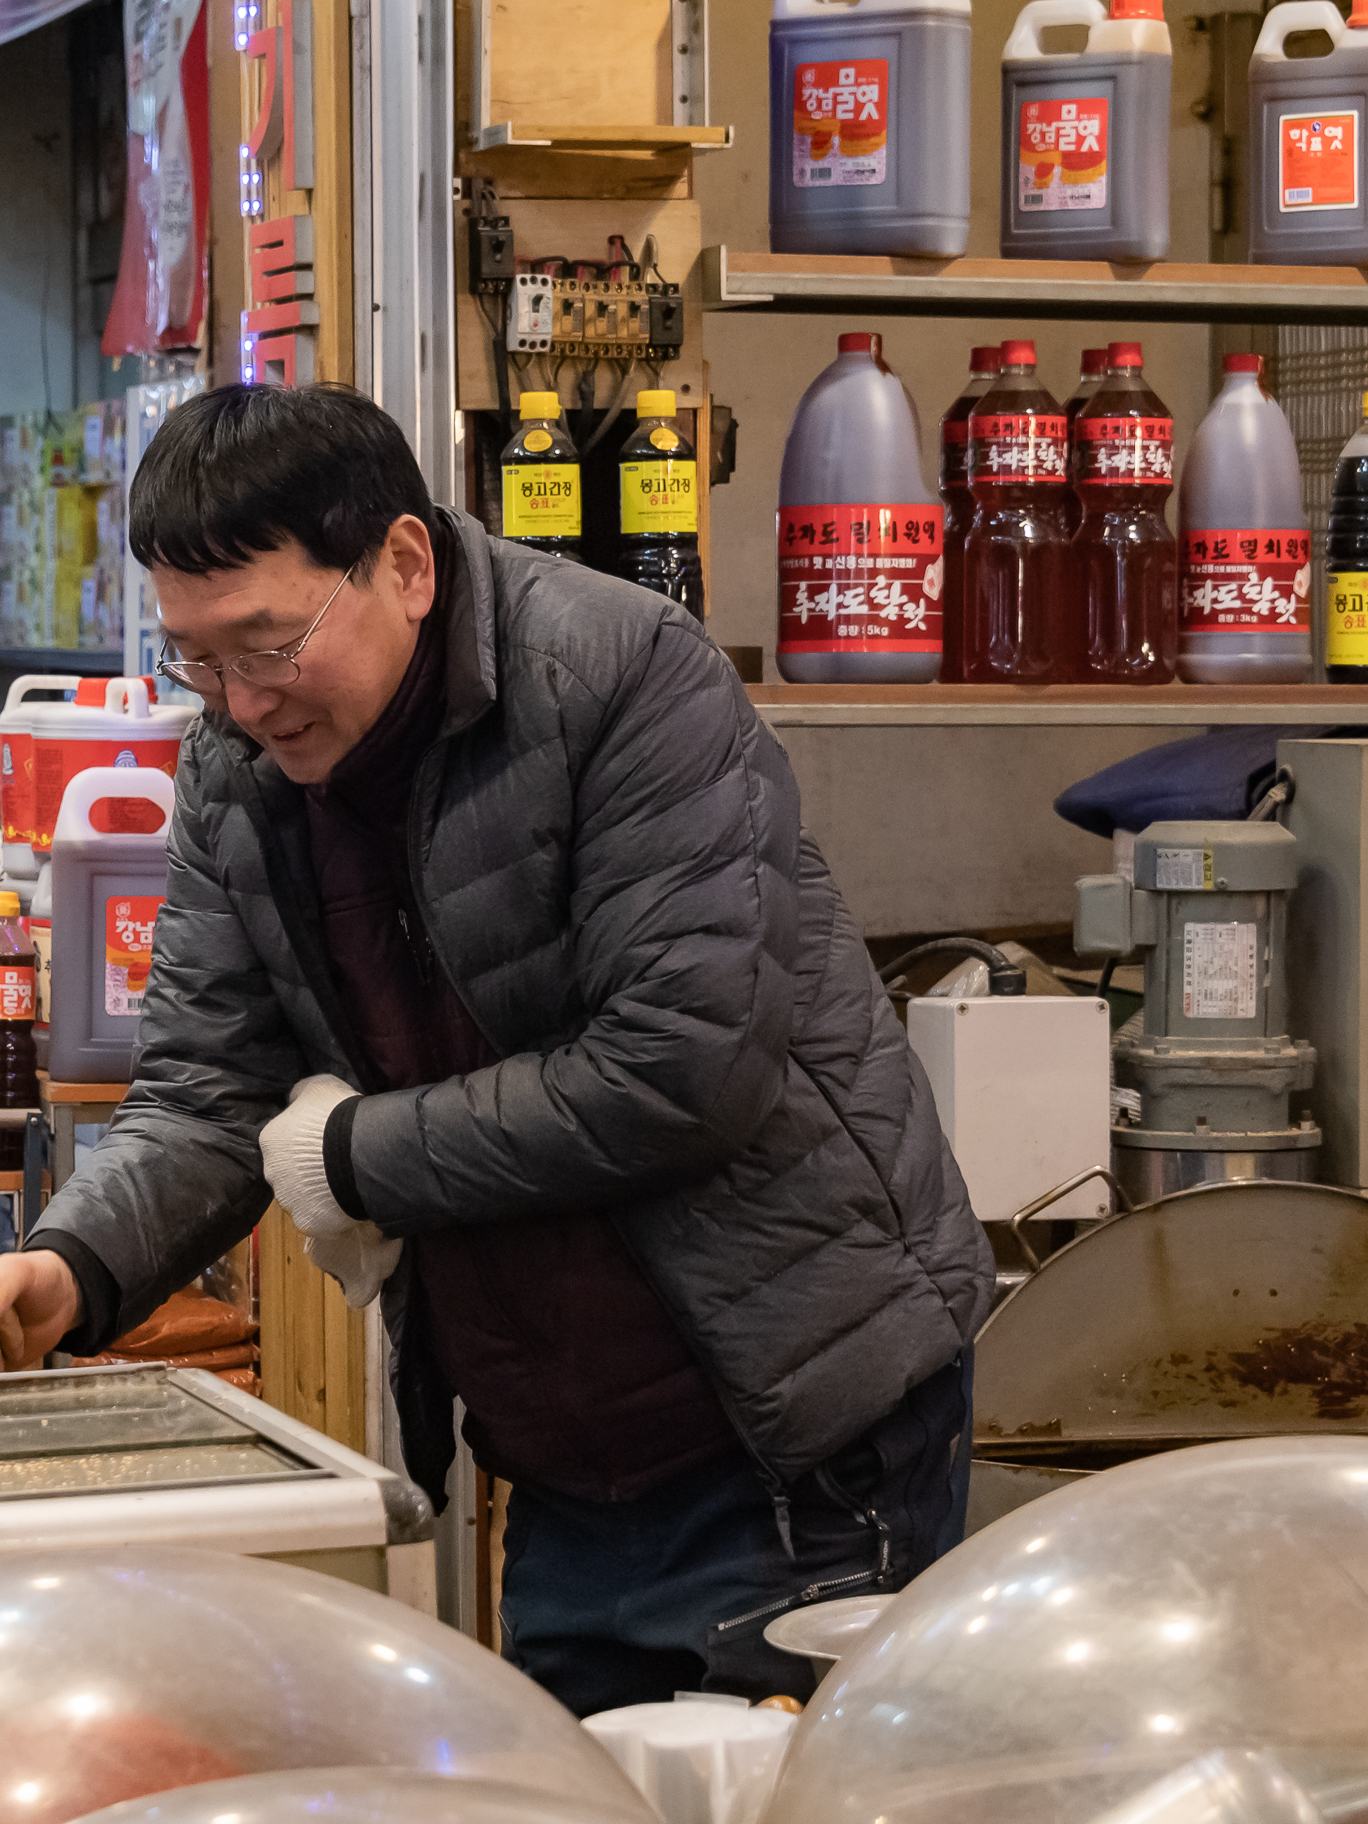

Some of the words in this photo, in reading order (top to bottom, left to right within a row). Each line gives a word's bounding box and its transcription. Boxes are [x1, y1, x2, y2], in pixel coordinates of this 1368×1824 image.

[802, 67, 879, 120] 강남물엿
[1026, 103, 1100, 152] 강남물엿
[521, 482, 572, 497] 몽고간장
[640, 478, 690, 494] 몽고간장
[792, 581, 869, 625] 추자도
